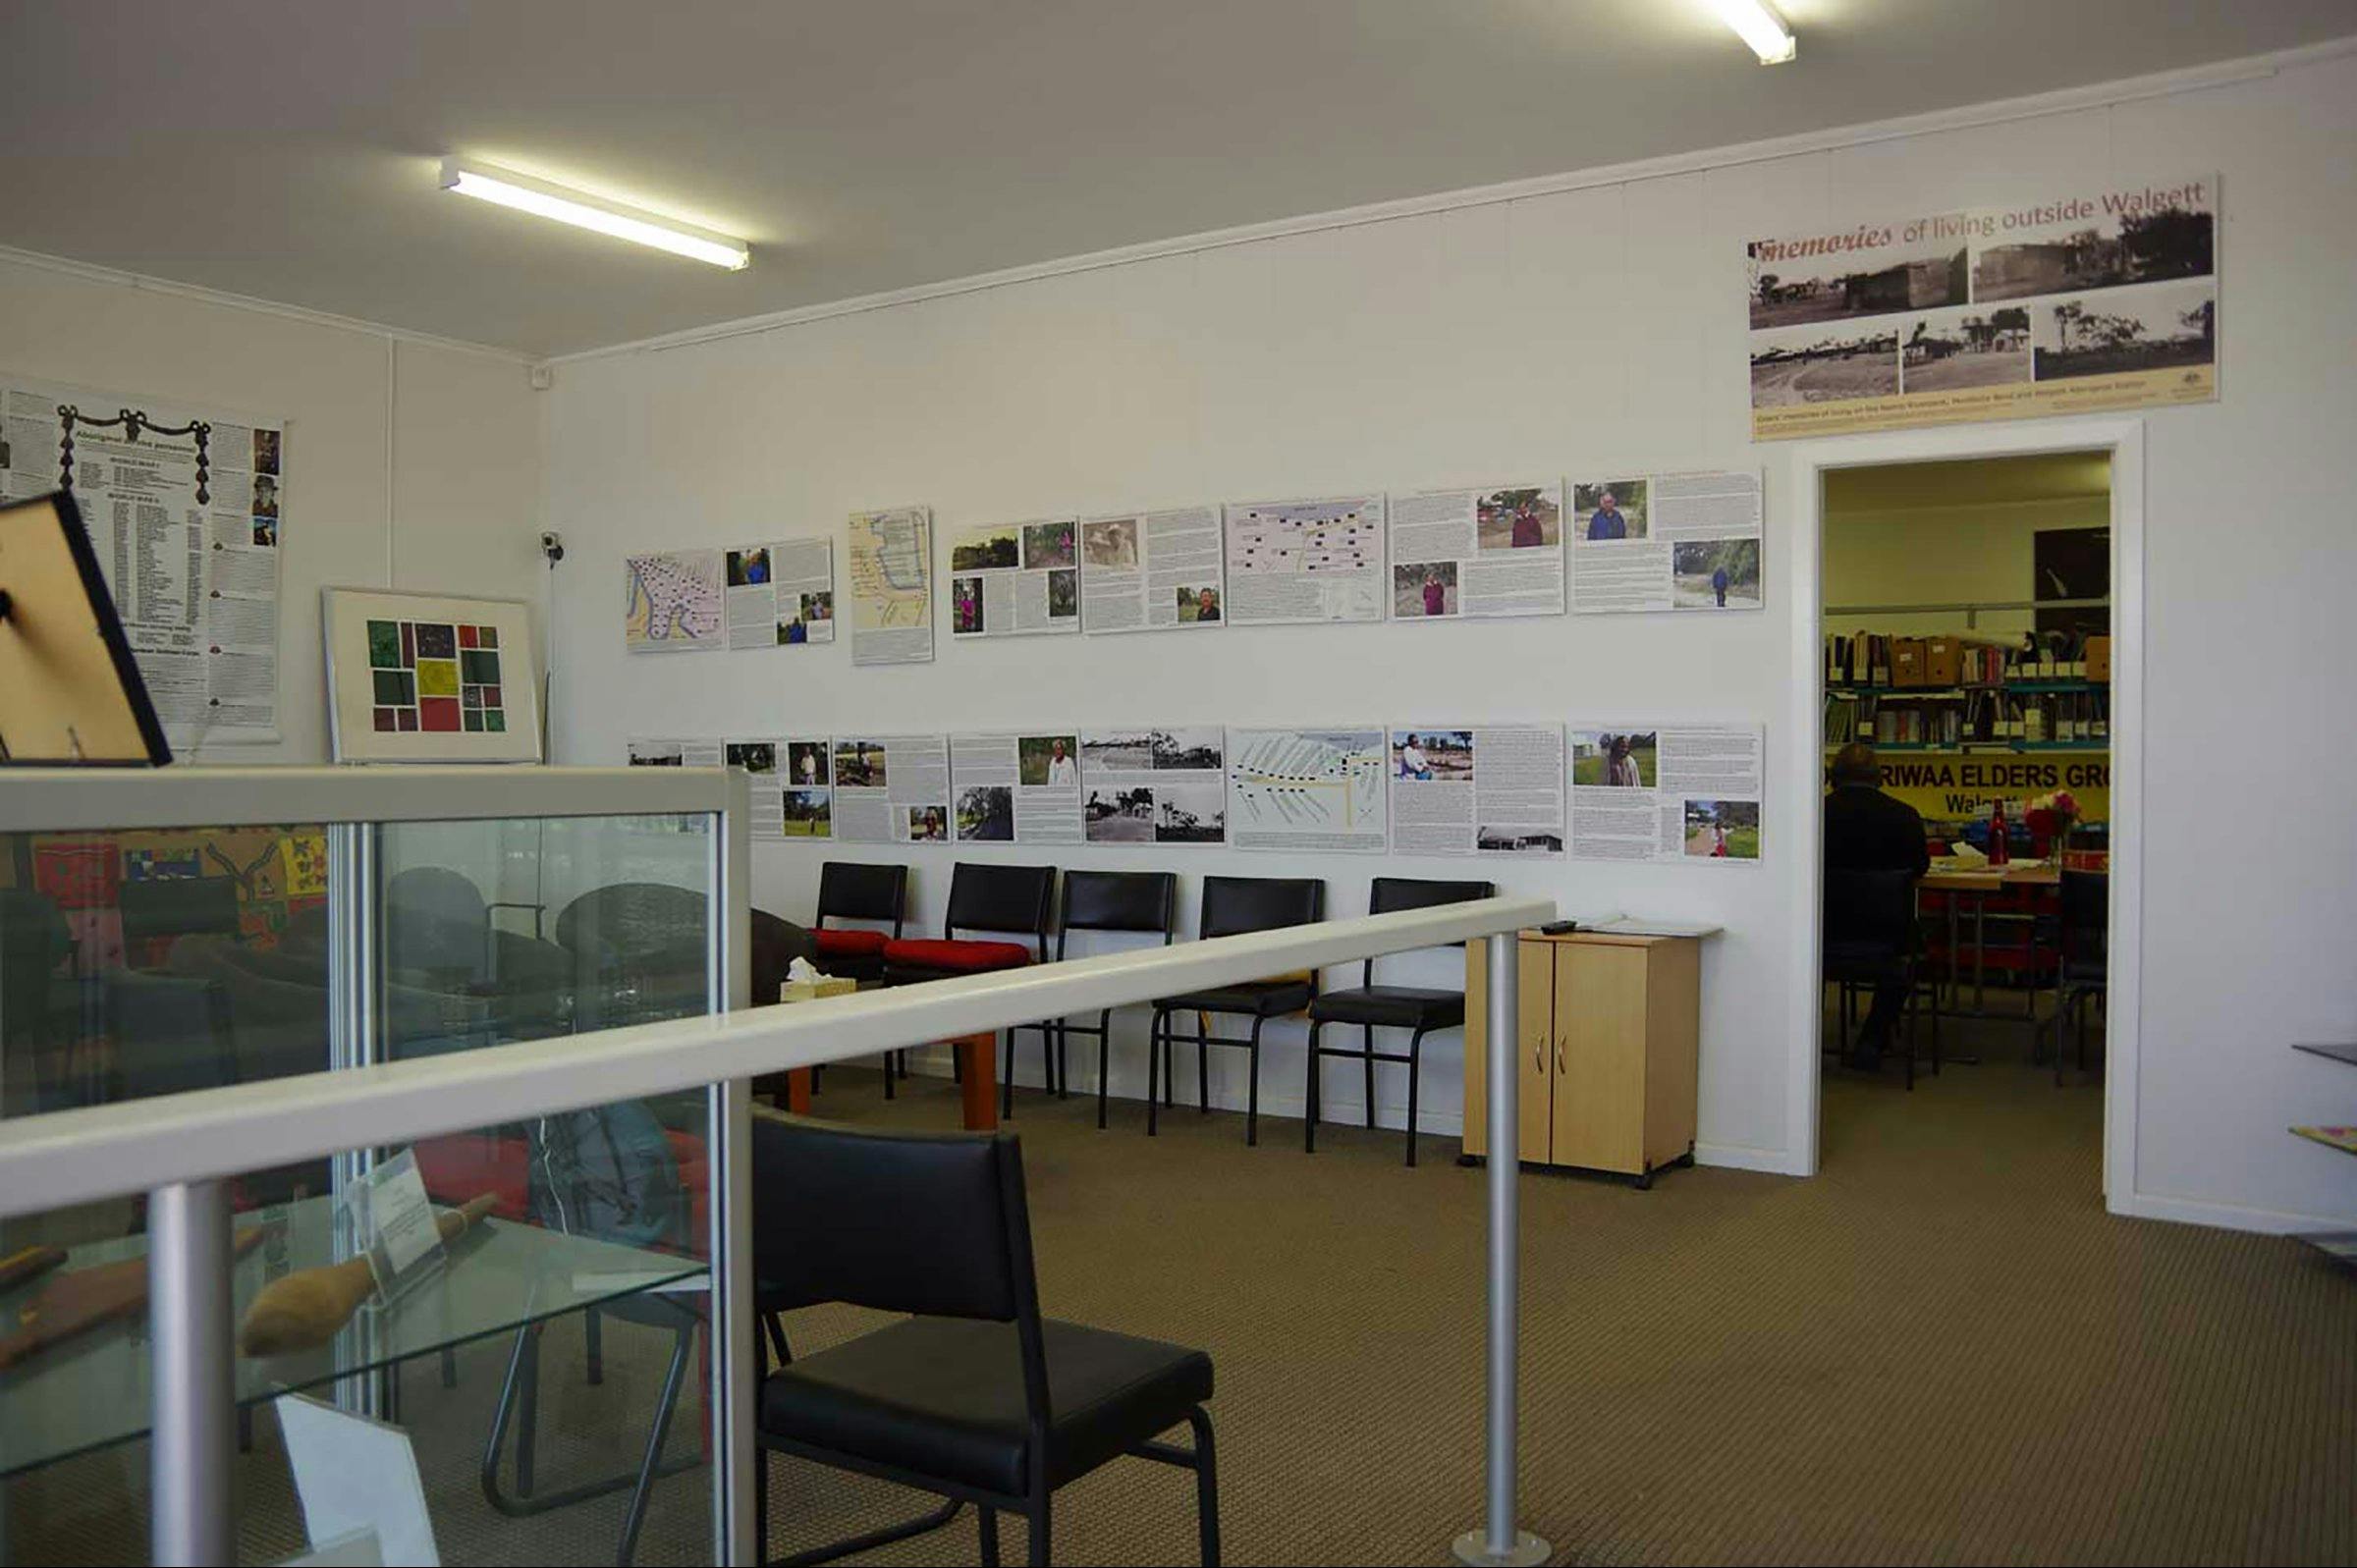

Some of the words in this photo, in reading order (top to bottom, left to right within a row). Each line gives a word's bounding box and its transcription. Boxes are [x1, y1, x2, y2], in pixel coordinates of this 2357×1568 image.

[1761, 225, 1891, 263] memories
[1903, 218, 1928, 243] of
[1933, 213, 1996, 239] living
[2002, 198, 2094, 230] outside
[2102, 182, 2205, 213] Walgett
[1961, 765, 2058, 787] ELDERS
